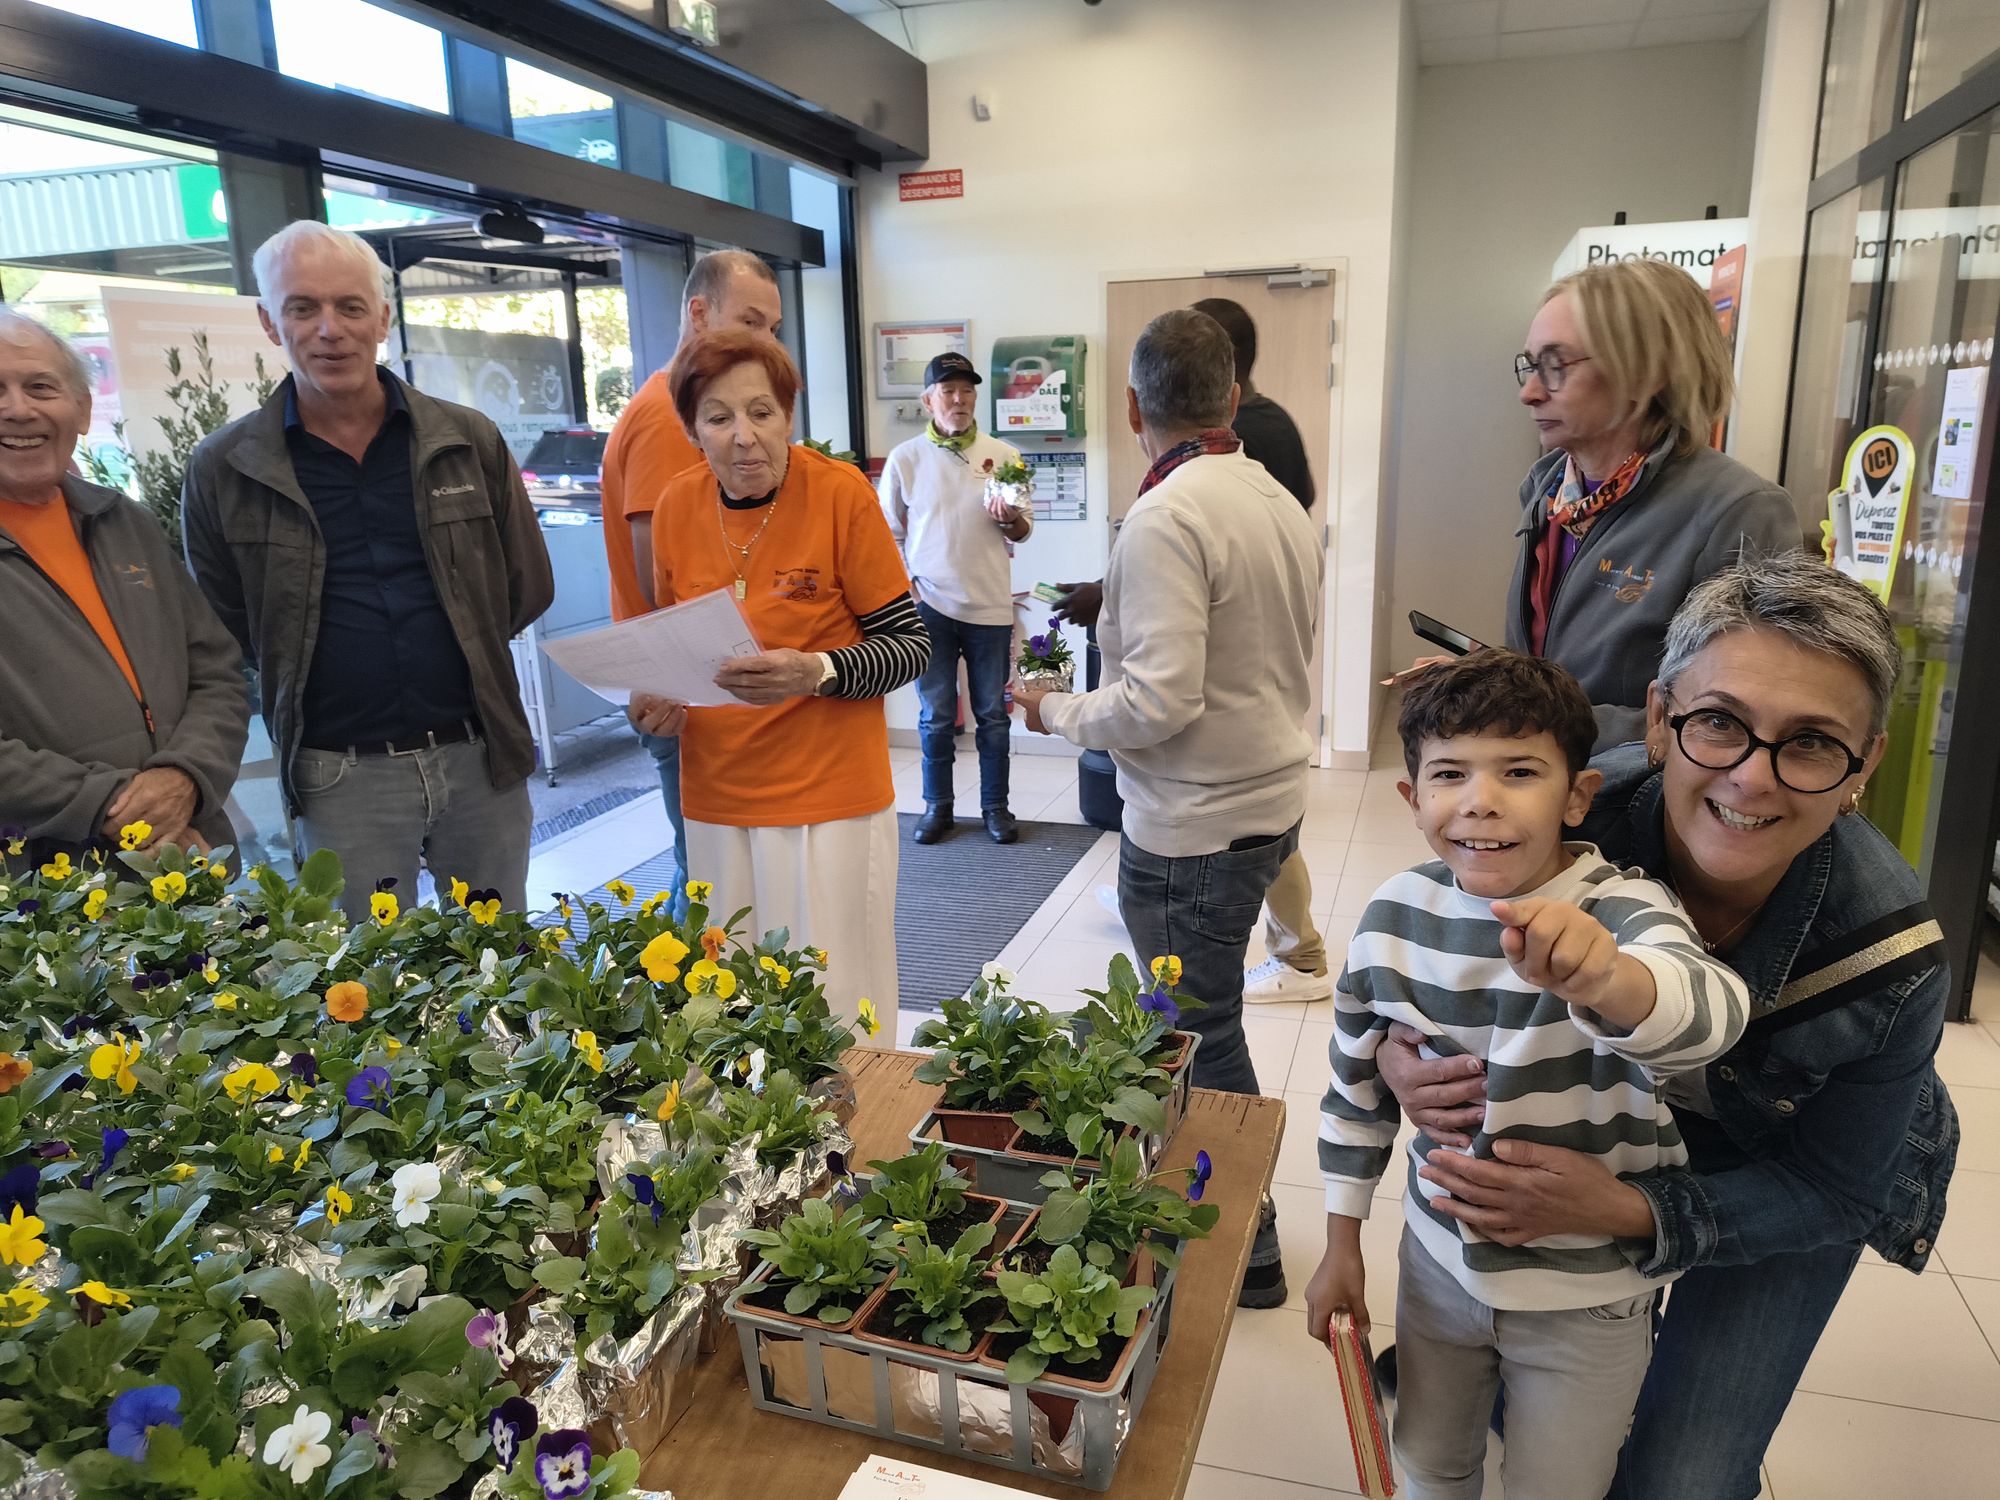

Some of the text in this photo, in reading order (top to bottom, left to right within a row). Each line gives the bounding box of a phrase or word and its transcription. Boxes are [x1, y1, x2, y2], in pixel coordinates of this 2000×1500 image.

[901, 172, 961, 186] COMMANDE DE
[1868, 446, 1892, 472] ICI
